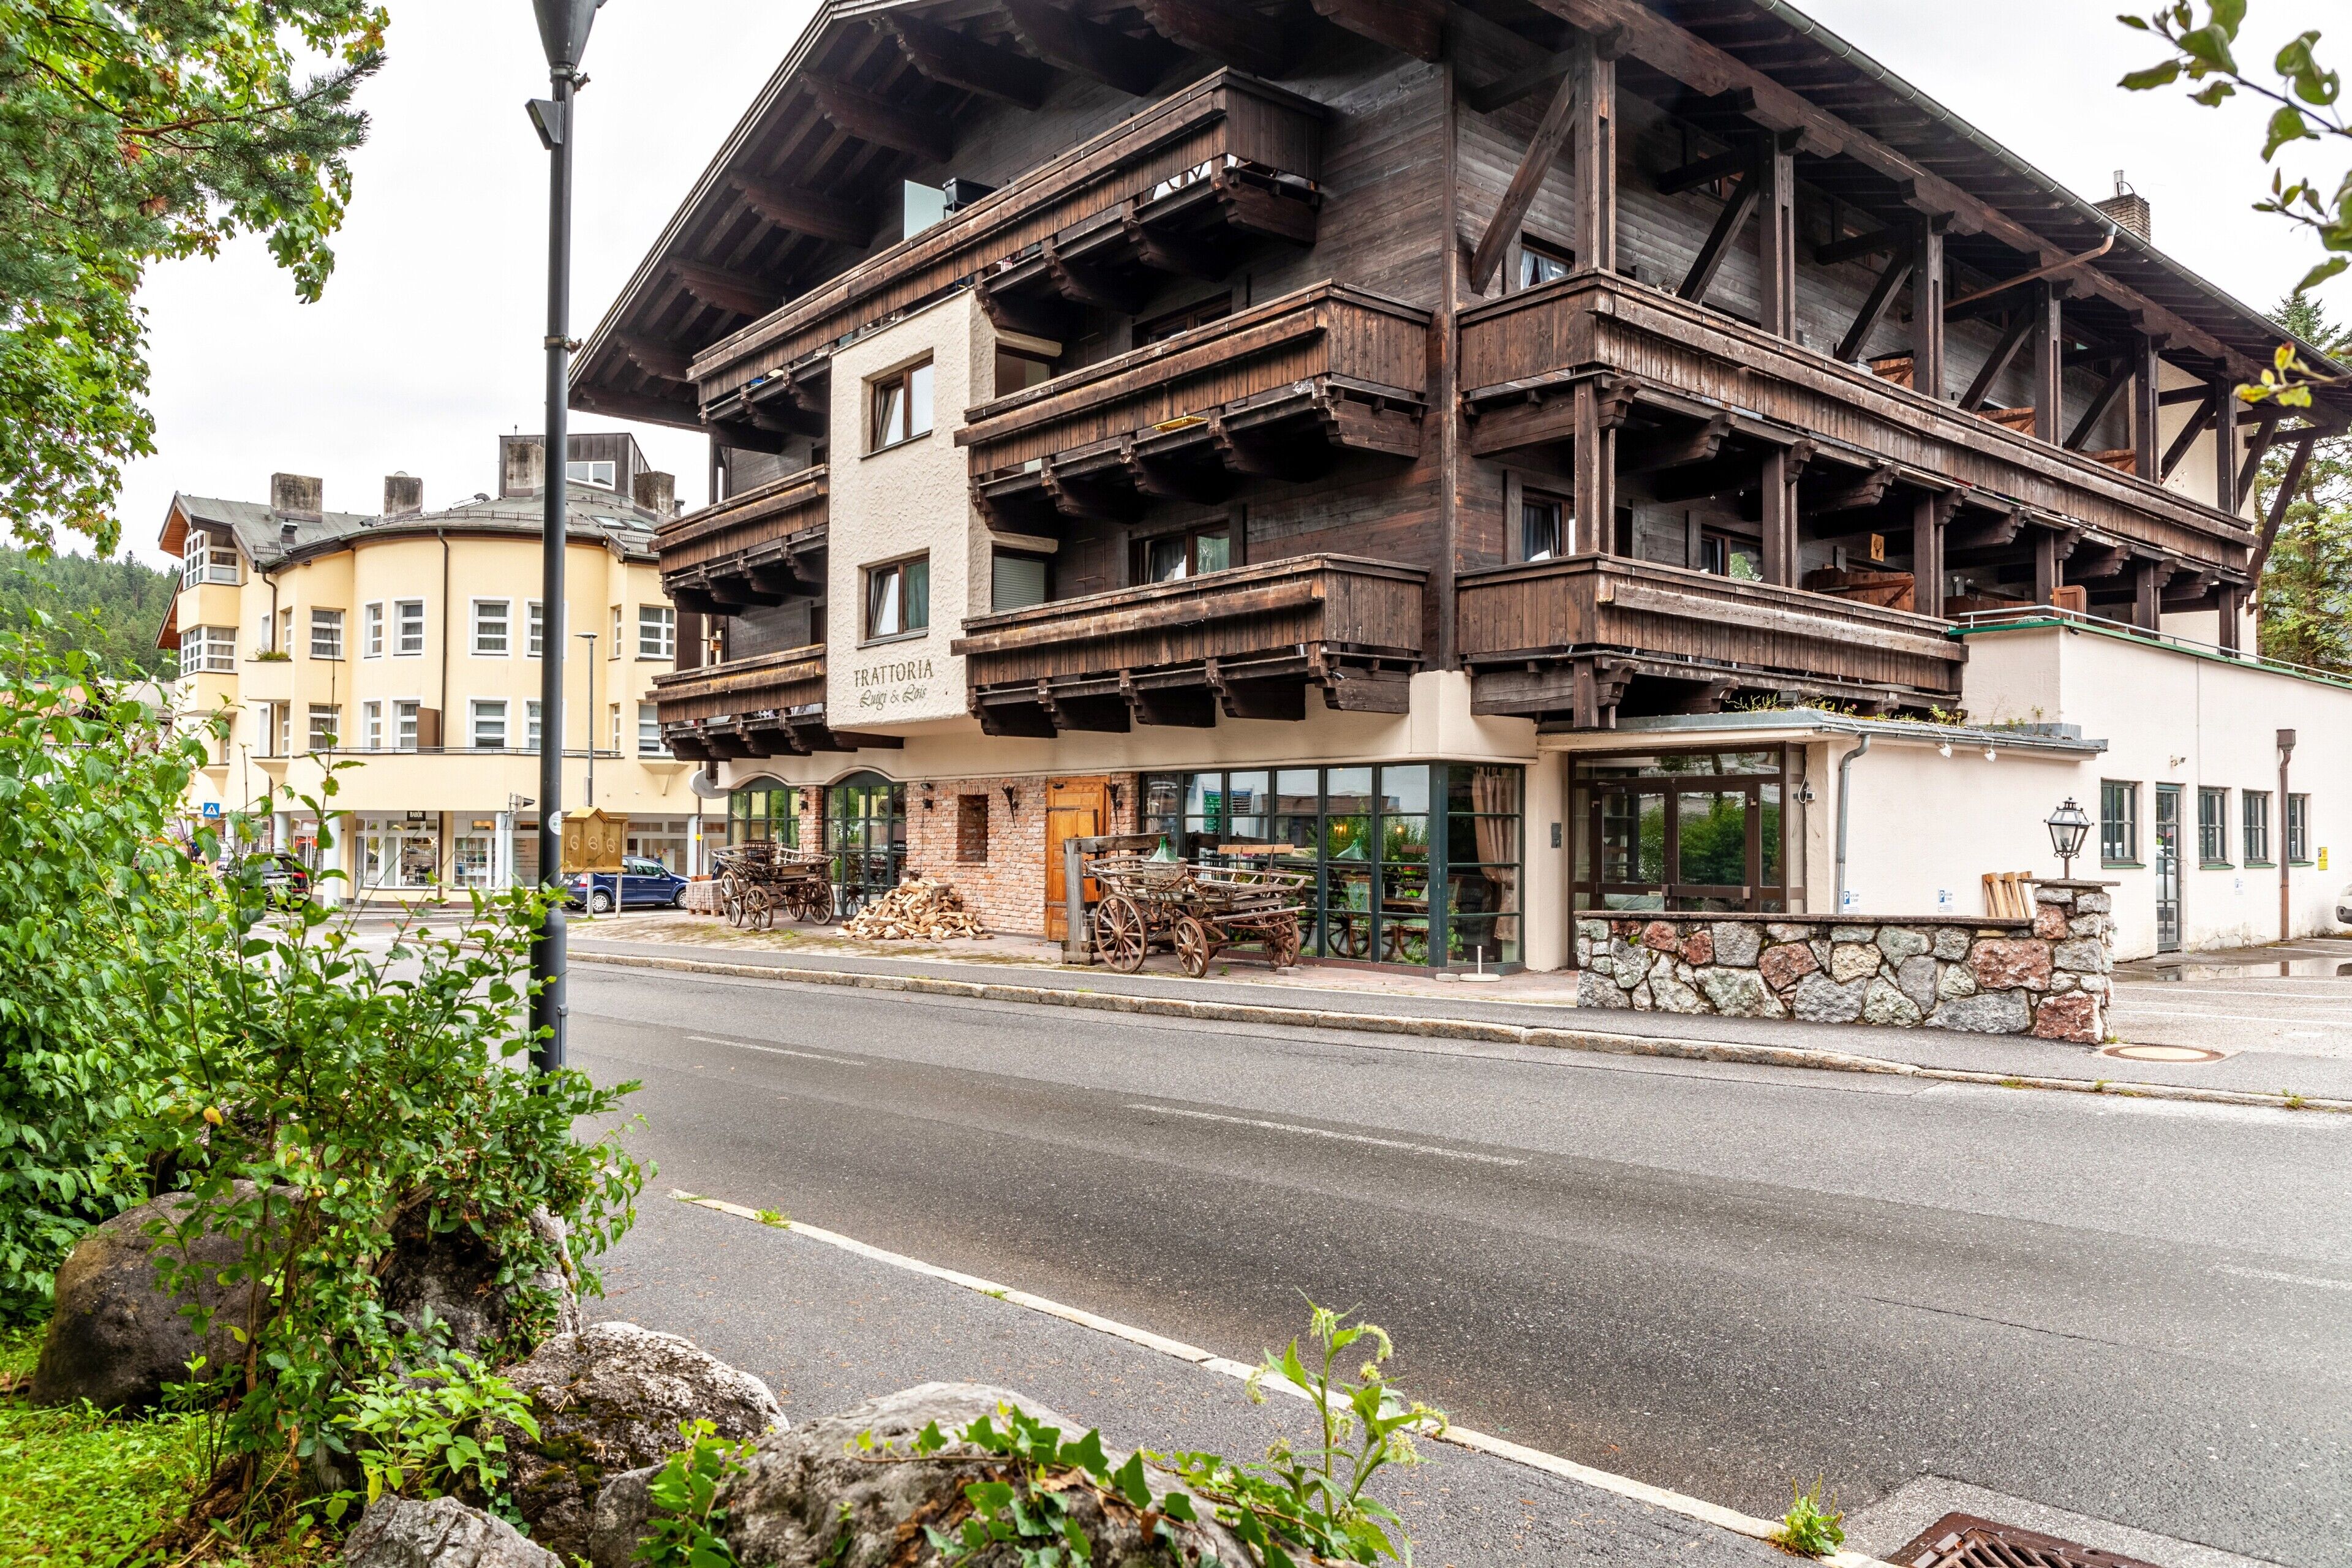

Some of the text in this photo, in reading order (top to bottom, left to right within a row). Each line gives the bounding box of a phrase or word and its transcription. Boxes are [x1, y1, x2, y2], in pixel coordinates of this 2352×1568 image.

[853, 659, 933, 687] TRATTORIA
[859, 684, 927, 710] Luigi & Lois
[570, 835, 579, 850] 6
[589, 836, 598, 850] 6
